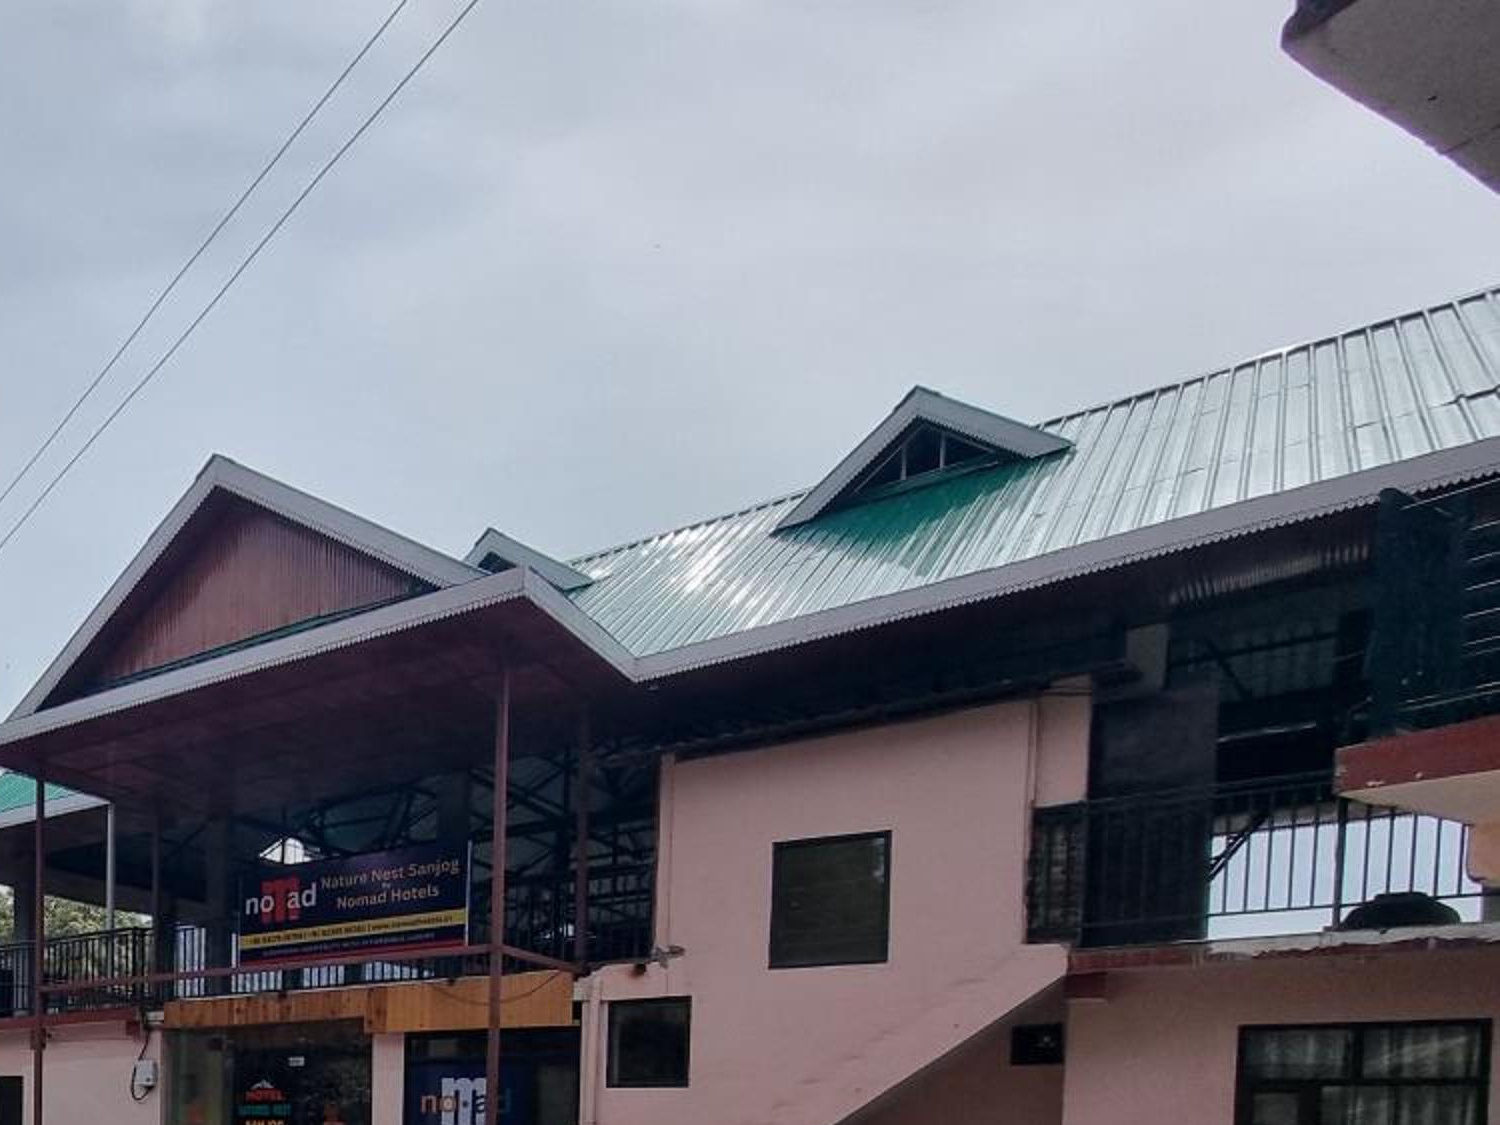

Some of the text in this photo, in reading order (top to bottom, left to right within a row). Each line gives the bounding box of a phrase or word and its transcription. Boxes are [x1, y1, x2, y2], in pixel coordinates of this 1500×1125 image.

[320, 857, 460, 889] Nature Nest Sanjog
[336, 883, 440, 909] Nomad Hotels
